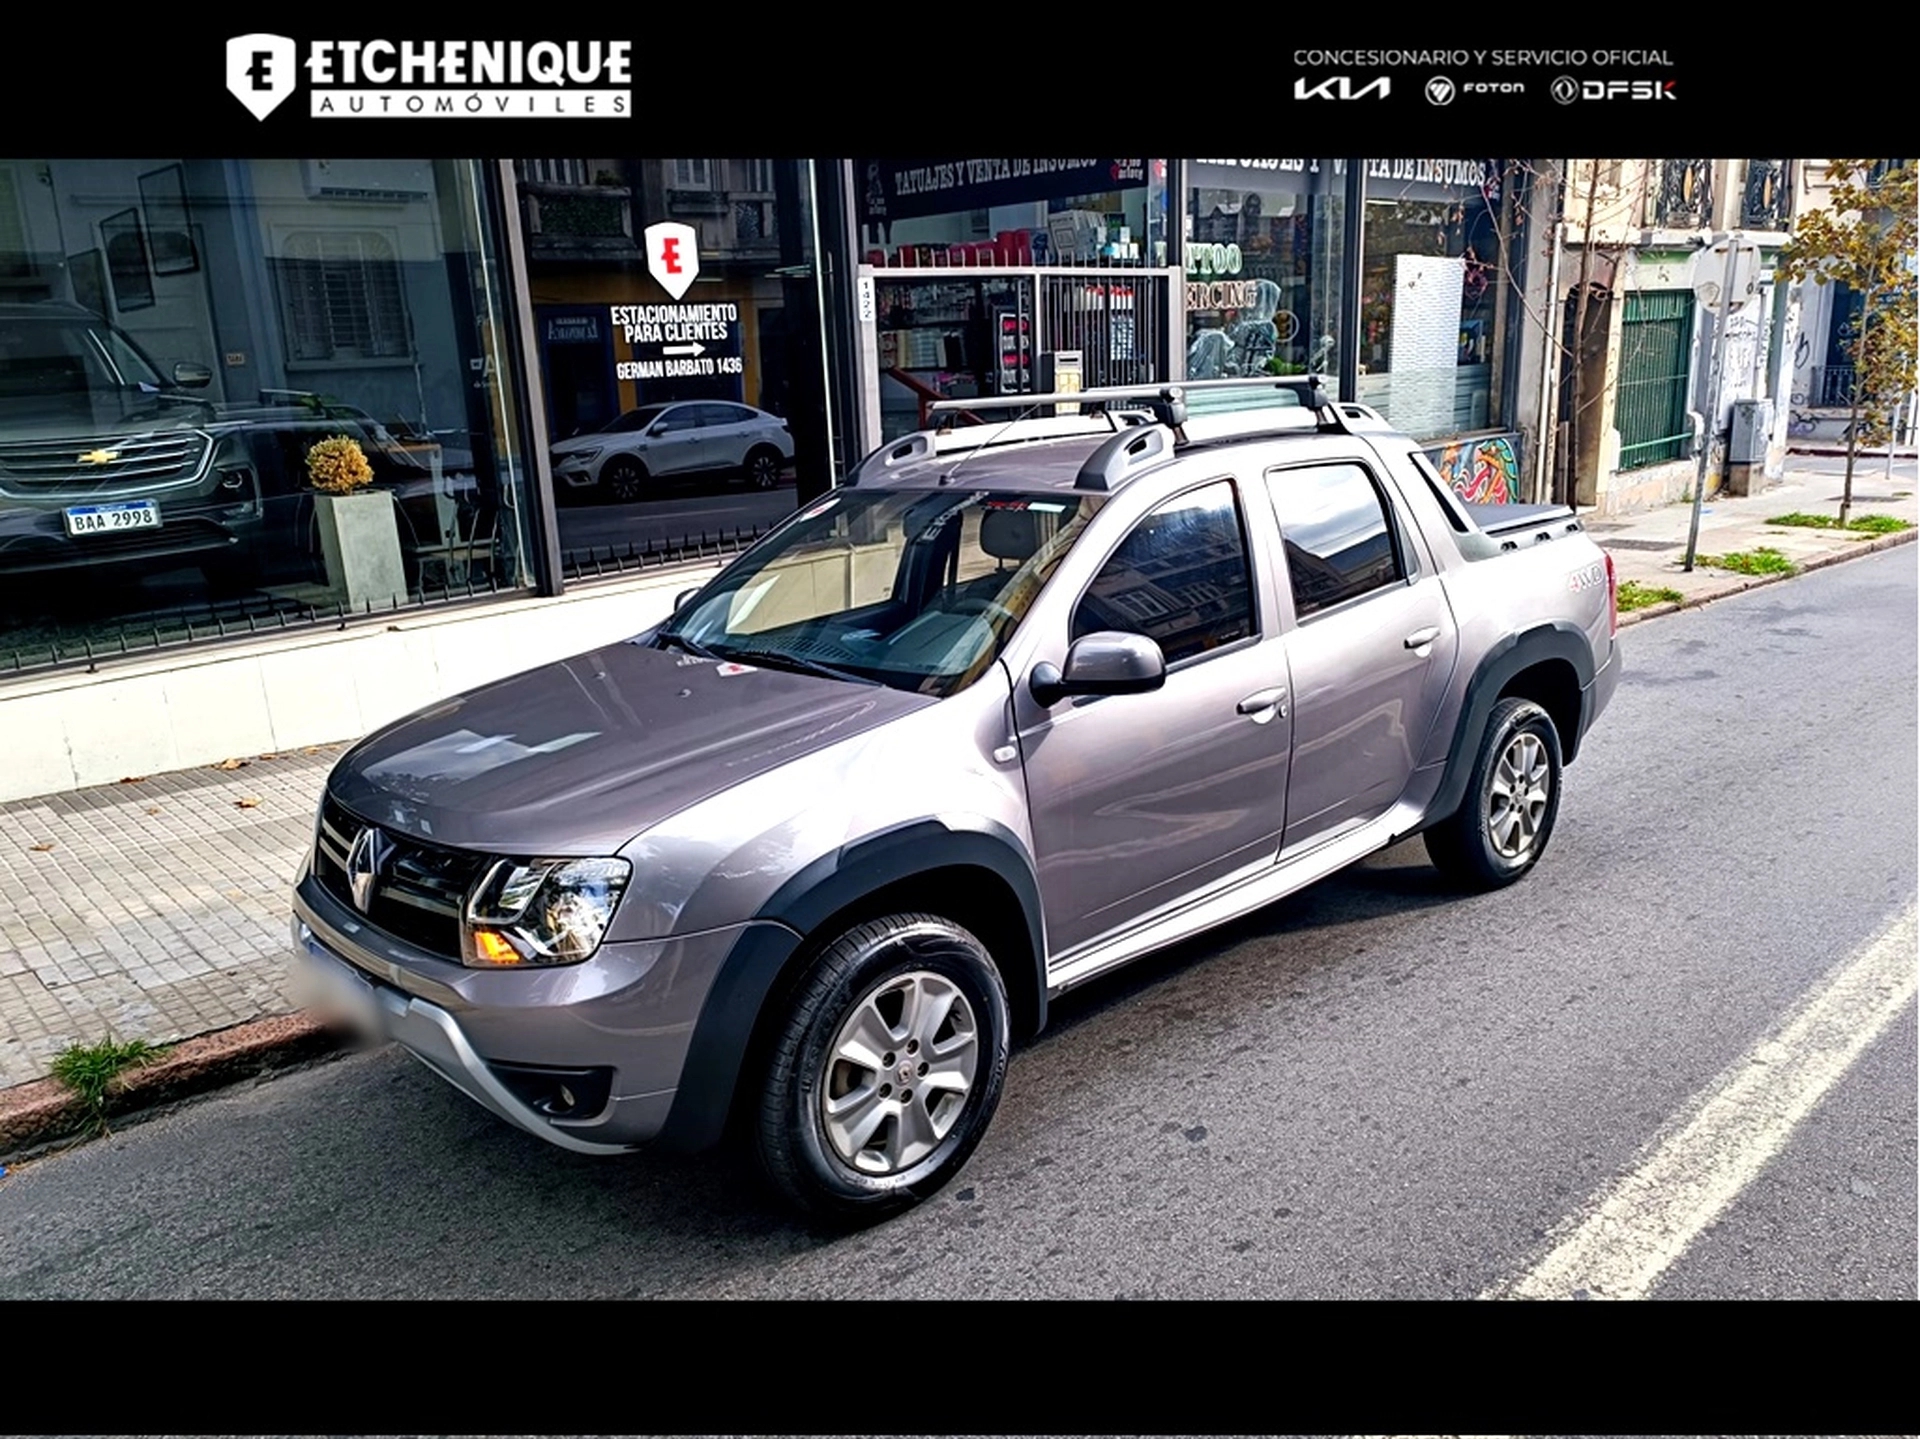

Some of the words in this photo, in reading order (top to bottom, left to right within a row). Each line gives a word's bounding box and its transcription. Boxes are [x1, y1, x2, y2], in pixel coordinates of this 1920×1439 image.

[895, 162, 955, 196] TATUAJES
[610, 303, 738, 325] ESTACIONAMIENTO
[624, 323, 663, 343] PARA
[664, 321, 728, 342] CLIENTES
[616, 361, 664, 380] GERMAN
[664, 358, 714, 378] BARBATO
[717, 356, 743, 375] 1436
[75, 514, 105, 531] BAA
[112, 510, 152, 527] 2998
